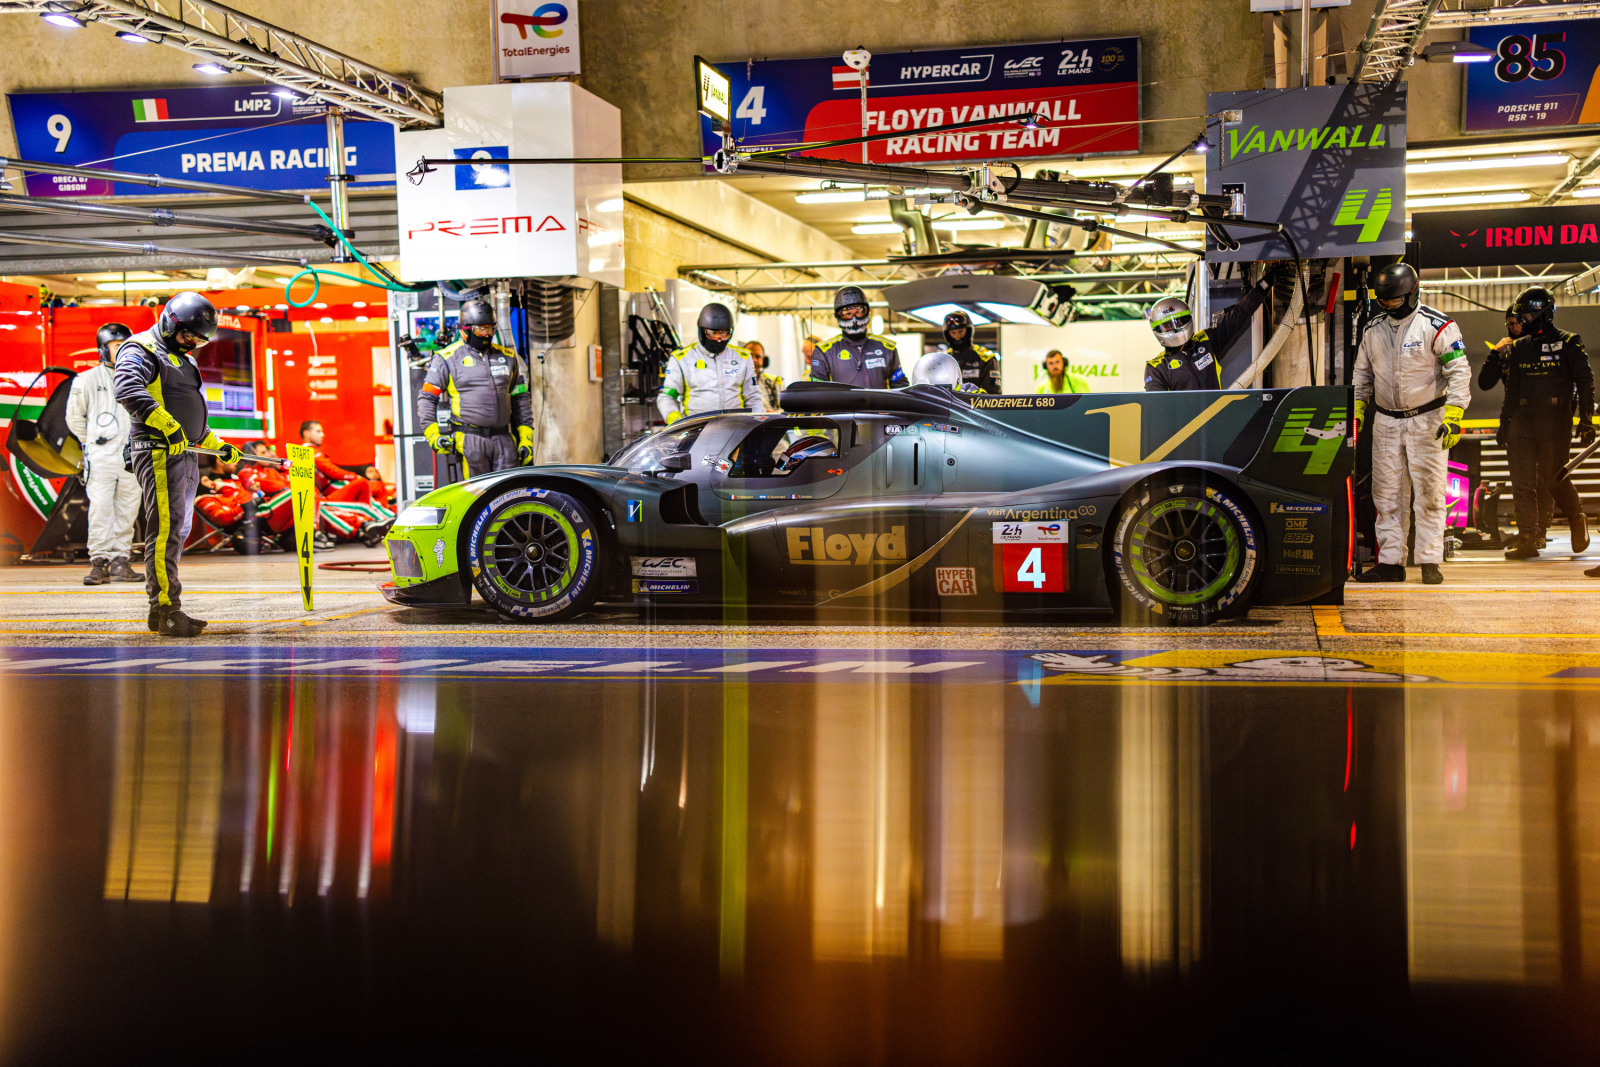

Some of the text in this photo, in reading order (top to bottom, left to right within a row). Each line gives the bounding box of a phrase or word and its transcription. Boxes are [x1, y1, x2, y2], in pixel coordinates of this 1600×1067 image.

[502, 45, 570, 57] TotalEnergies
[1058, 49, 1093, 69] 24h
[1101, 54, 1116, 63] 100
[1494, 32, 1566, 82] 85
[900, 62, 981, 80] HYPERCAR
[1003, 56, 1044, 69] WEC
[1067, 67, 1091, 75] MANS
[234, 99, 271, 112] LMP2
[736, 86, 767, 125] 4
[1498, 102, 1558, 113] PORSCHE 911
[865, 99, 1081, 131] FLOYD VANWALL
[1508, 114, 1526, 122] RSR
[1536, 112, 1546, 120] 19
[47, 113, 72, 152] 9
[886, 128, 1060, 155] RACING TEAM
[1226, 124, 1386, 160] VANWALL
[181, 146, 357, 173] PREMA RACIG
[1333, 187, 1391, 242] 4
[408, 215, 566, 239] PREMA
[1486, 223, 1600, 247] IRON DA
[969, 397, 1055, 409] VANDERVELL 680
[885, 425, 901, 434] FIA
[1273, 407, 1347, 474] 4
[292, 447, 310, 460] START
[291, 466, 313, 479] ENGINE
[492, 496, 505, 506] PILOT
[987, 508, 1006, 516] Visit
[1005, 506, 1078, 522] Argentina
[1222, 499, 1254, 546] MICHELIN
[470, 508, 489, 557] MICHELIN
[1001, 524, 1022, 535] 24h
[1285, 520, 1308, 528] OMP
[786, 526, 906, 565] Floyd
[1284, 533, 1314, 543] BBS
[301, 532, 310, 564] 4
[1283, 549, 1302, 559] H&R
[641, 557, 684, 568] WEC
[1016, 547, 1046, 588] 4
[571, 549, 592, 598] MICHELIN
[937, 569, 973, 580] HYPER
[1115, 556, 1146, 602] MICHELIN
[939, 580, 974, 595] CAR
